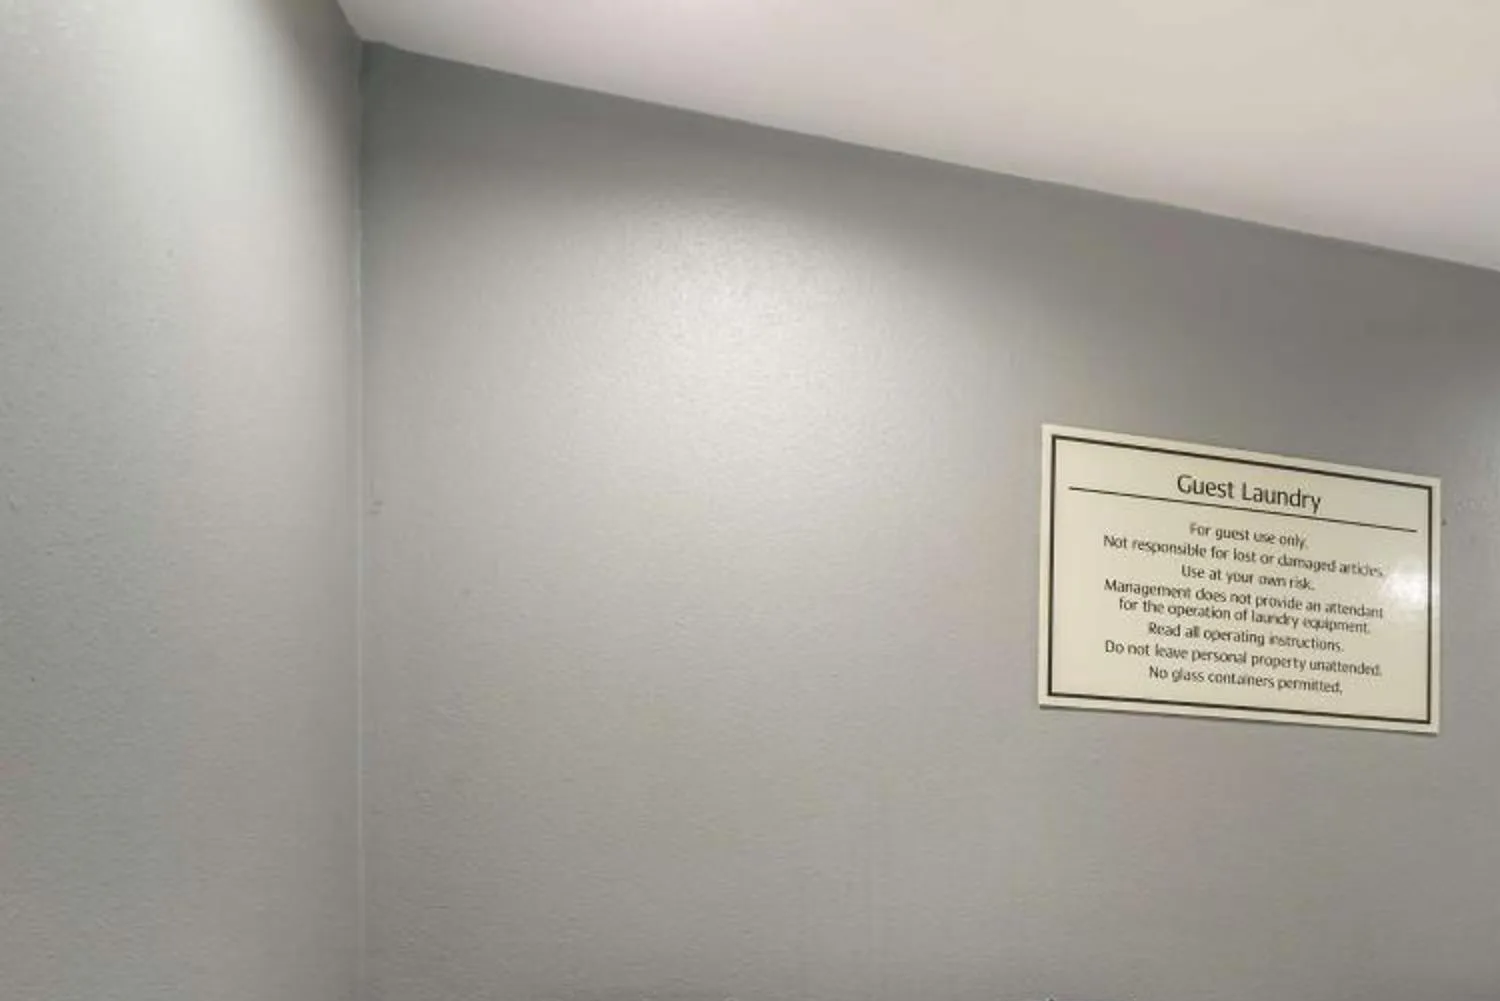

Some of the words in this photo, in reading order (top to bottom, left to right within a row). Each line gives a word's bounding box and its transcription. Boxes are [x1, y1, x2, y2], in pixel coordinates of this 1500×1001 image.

[1177, 474, 1235, 499] Guest
[1242, 482, 1321, 514] Laundry
[1189, 522, 1211, 536] For
[1215, 527, 1250, 542] guest
[1253, 532, 1276, 544] use
[1279, 534, 1309, 550] only.
[1103, 535, 1127, 549] Not
[1132, 540, 1207, 558] responsible
[1211, 546, 1229, 560] for
[1233, 547, 1256, 563] lost
[1260, 553, 1275, 565] or
[1277, 554, 1337, 573] damaged
[1339, 561, 1384, 577] articles.
[1181, 564, 1205, 578] Use
[1209, 568, 1222, 580] at
[1226, 571, 1254, 584] your
[1258, 574, 1287, 587] own
[1289, 577, 1316, 590] risk.
[1104, 578, 1192, 598] Management
[1195, 587, 1226, 602] does
[1230, 592, 1252, 605] not
[1255, 595, 1303, 611] provide
[1306, 601, 1321, 612] an
[1325, 603, 1384, 619] attendant
[1119, 596, 1138, 610] for
[1143, 599, 1165, 613] the
[1167, 604, 1231, 621] operation
[1234, 608, 1248, 621] of
[1251, 610, 1299, 629] laundry
[1302, 618, 1371, 634] equipment.
[1148, 621, 1181, 637] Read
[1185, 625, 1200, 638] all
[1203, 628, 1265, 647] operating
[1269, 632, 1344, 652] instructions.
[1105, 639, 1124, 654] Do
[1127, 644, 1150, 657] not
[1155, 643, 1189, 660] leave
[1191, 649, 1247, 664] personal
[1251, 653, 1307, 673] property
[1309, 659, 1382, 677] unattended.
[1149, 665, 1168, 680] No
[1171, 667, 1205, 683] glass
[1207, 672, 1275, 689] containers
